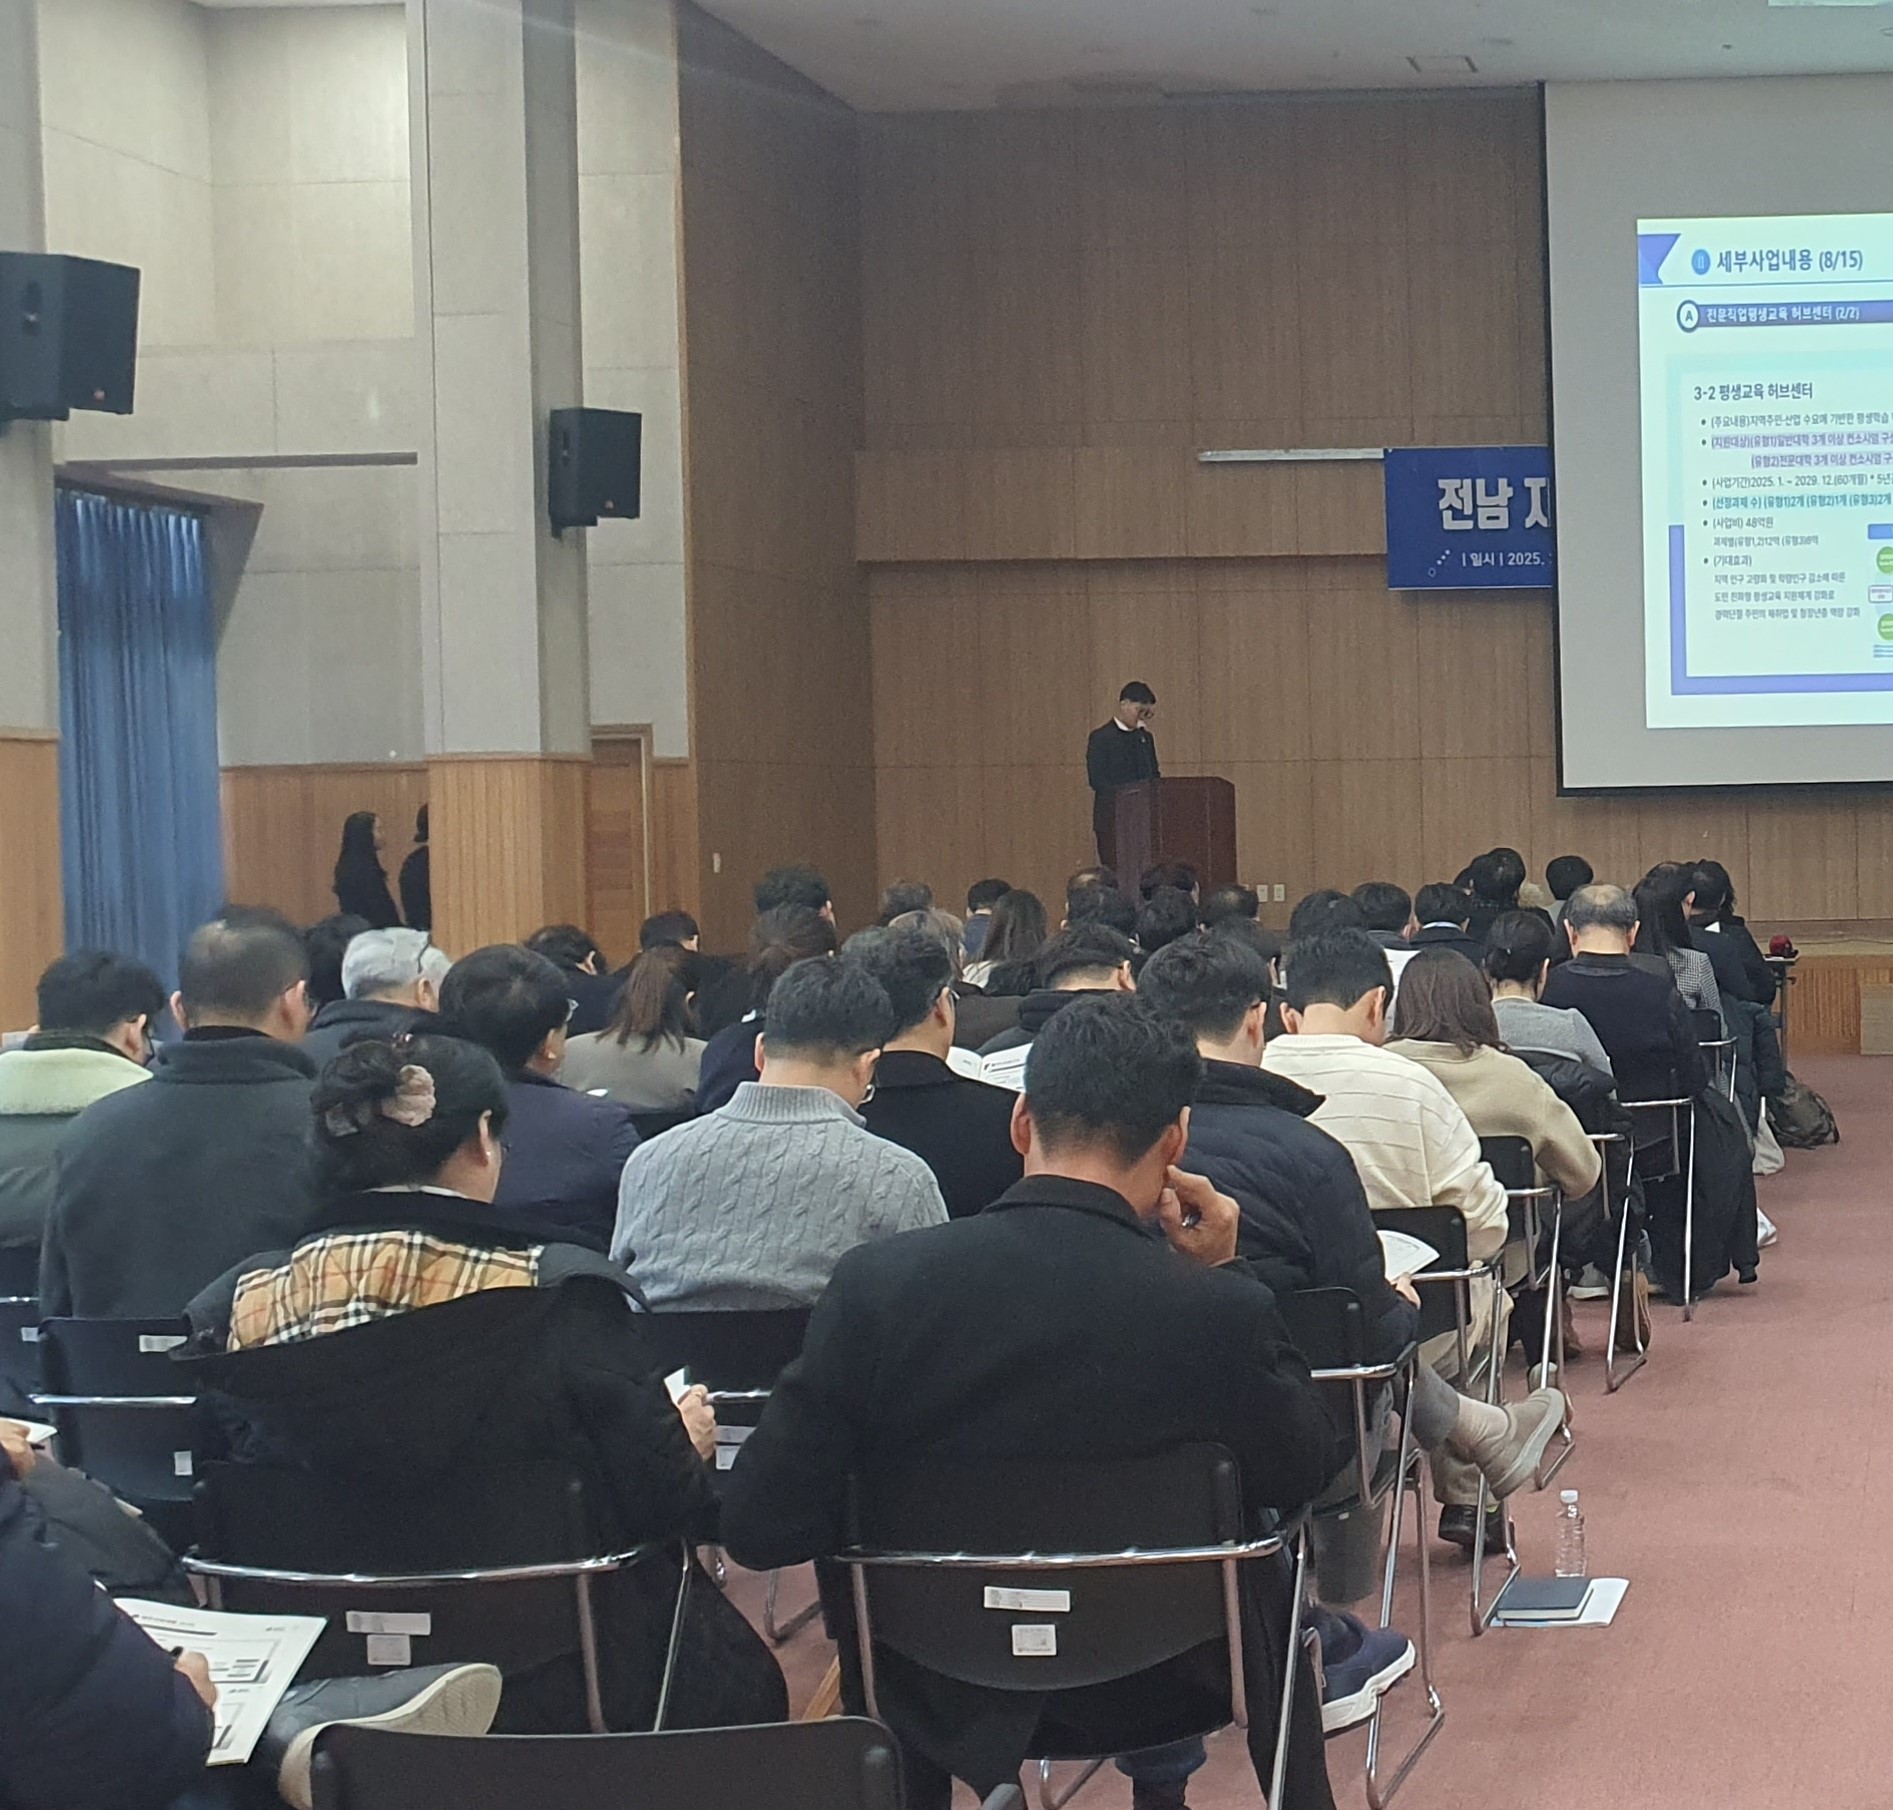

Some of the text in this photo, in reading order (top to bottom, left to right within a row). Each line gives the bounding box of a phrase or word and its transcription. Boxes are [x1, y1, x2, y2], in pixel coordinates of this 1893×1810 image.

[1717, 249, 1813, 272] 세부사업내용
[1819, 249, 1863, 271] (8/15)
[1685, 311, 1693, 322] A
[1707, 307, 1788, 323] 전문직업평생교육
[1791, 305, 1832, 320] 허브센터
[1694, 382, 1813, 401] 3-2 평생교육 허브센터
[1437, 477, 1513, 530] 전남
[1470, 551, 1546, 567] 일시 2025.
